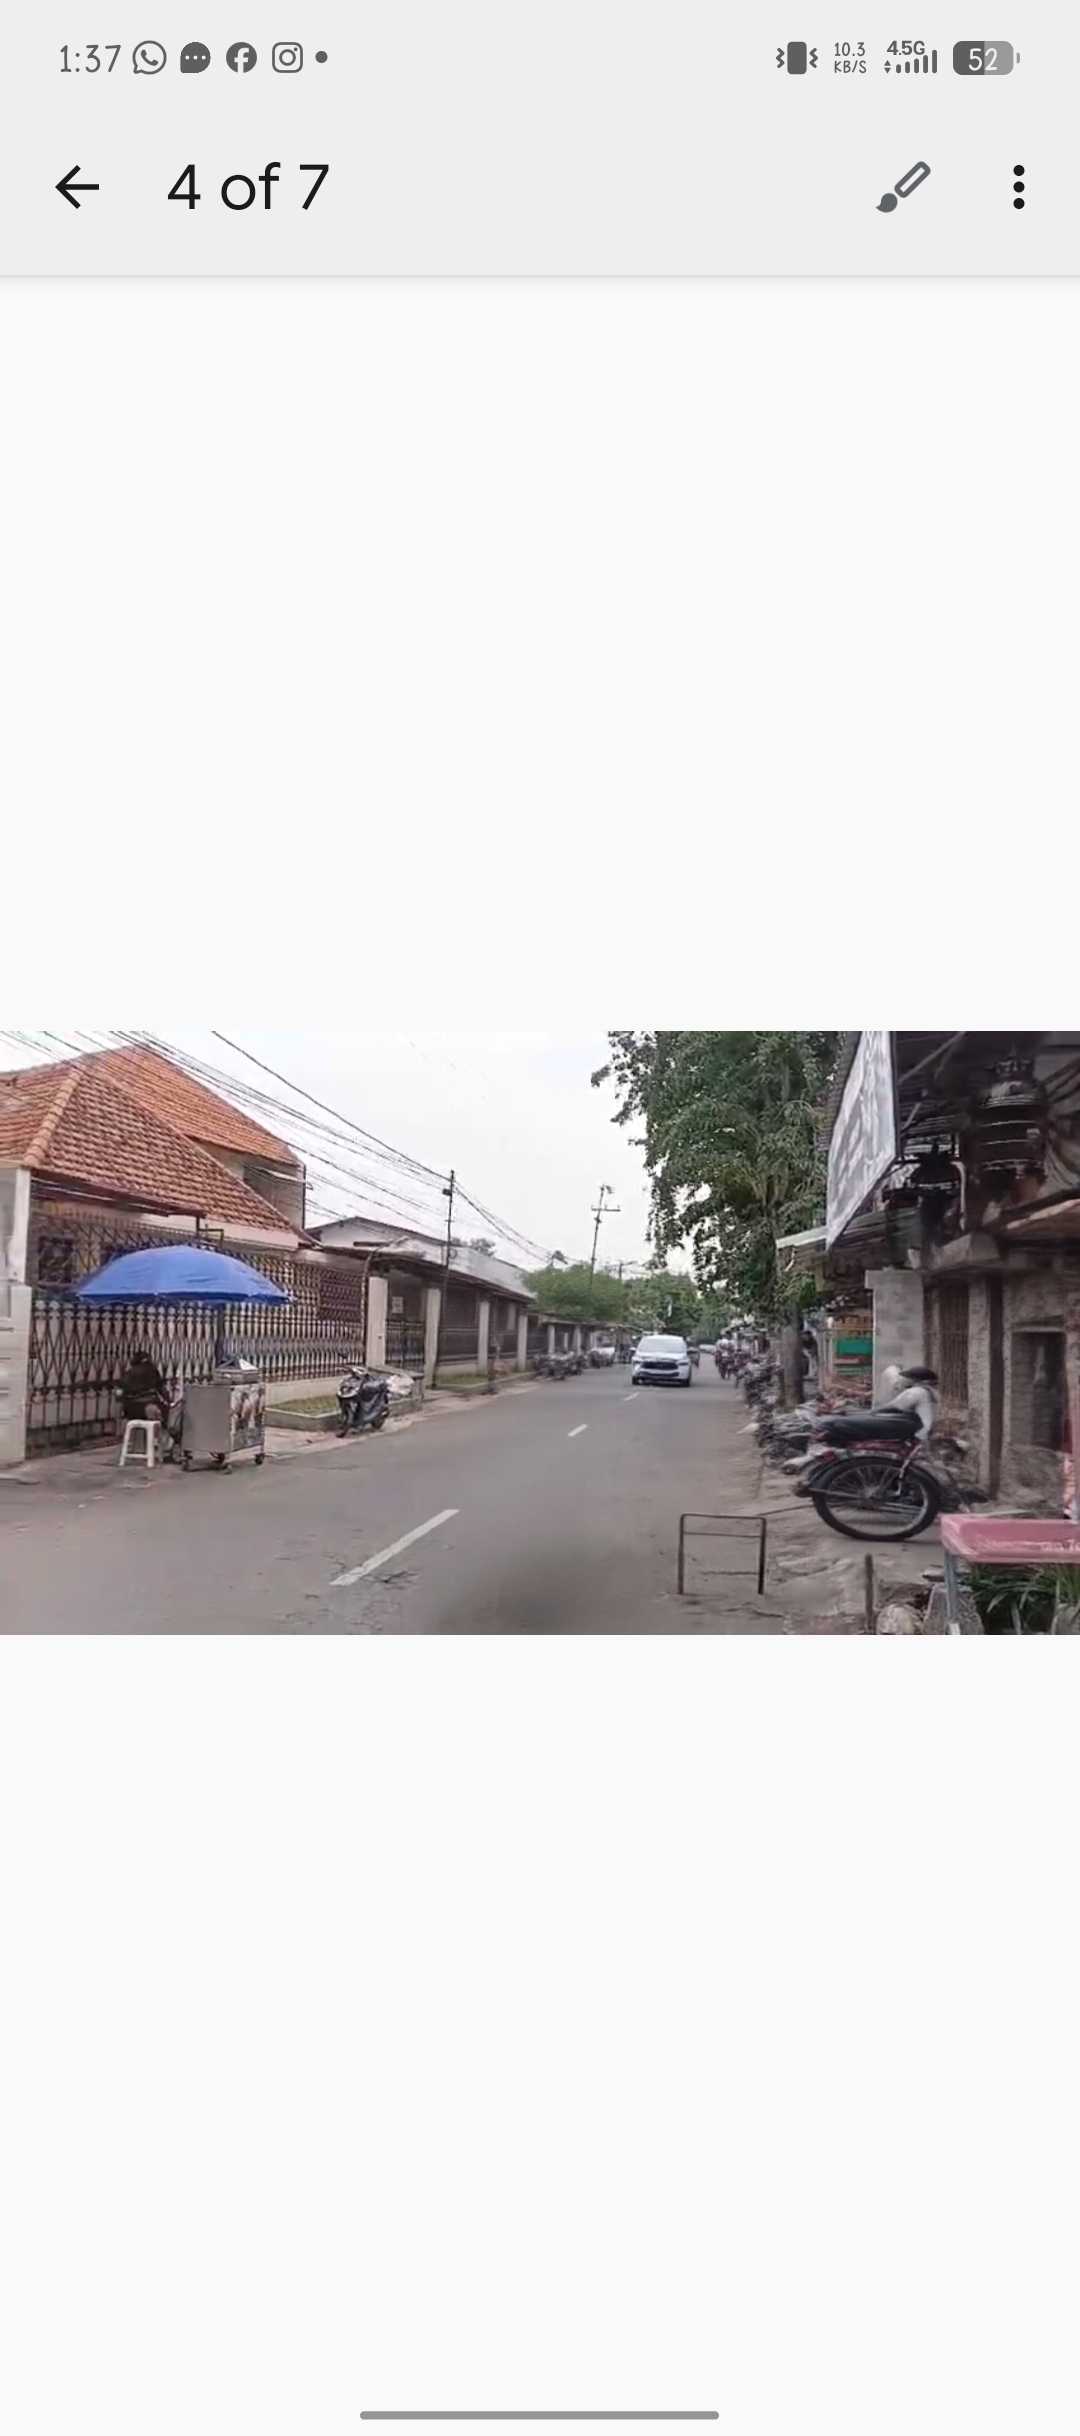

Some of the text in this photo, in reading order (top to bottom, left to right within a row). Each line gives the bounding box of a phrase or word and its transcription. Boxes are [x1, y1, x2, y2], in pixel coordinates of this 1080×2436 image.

[834, 42, 866, 57] 10.3
[887, 40, 926, 56] 4.5G
[61, 45, 121, 73] 1:37
[834, 60, 867, 74] KB/S
[968, 48, 998, 71] 52
[168, 161, 329, 210] 4 of 7
